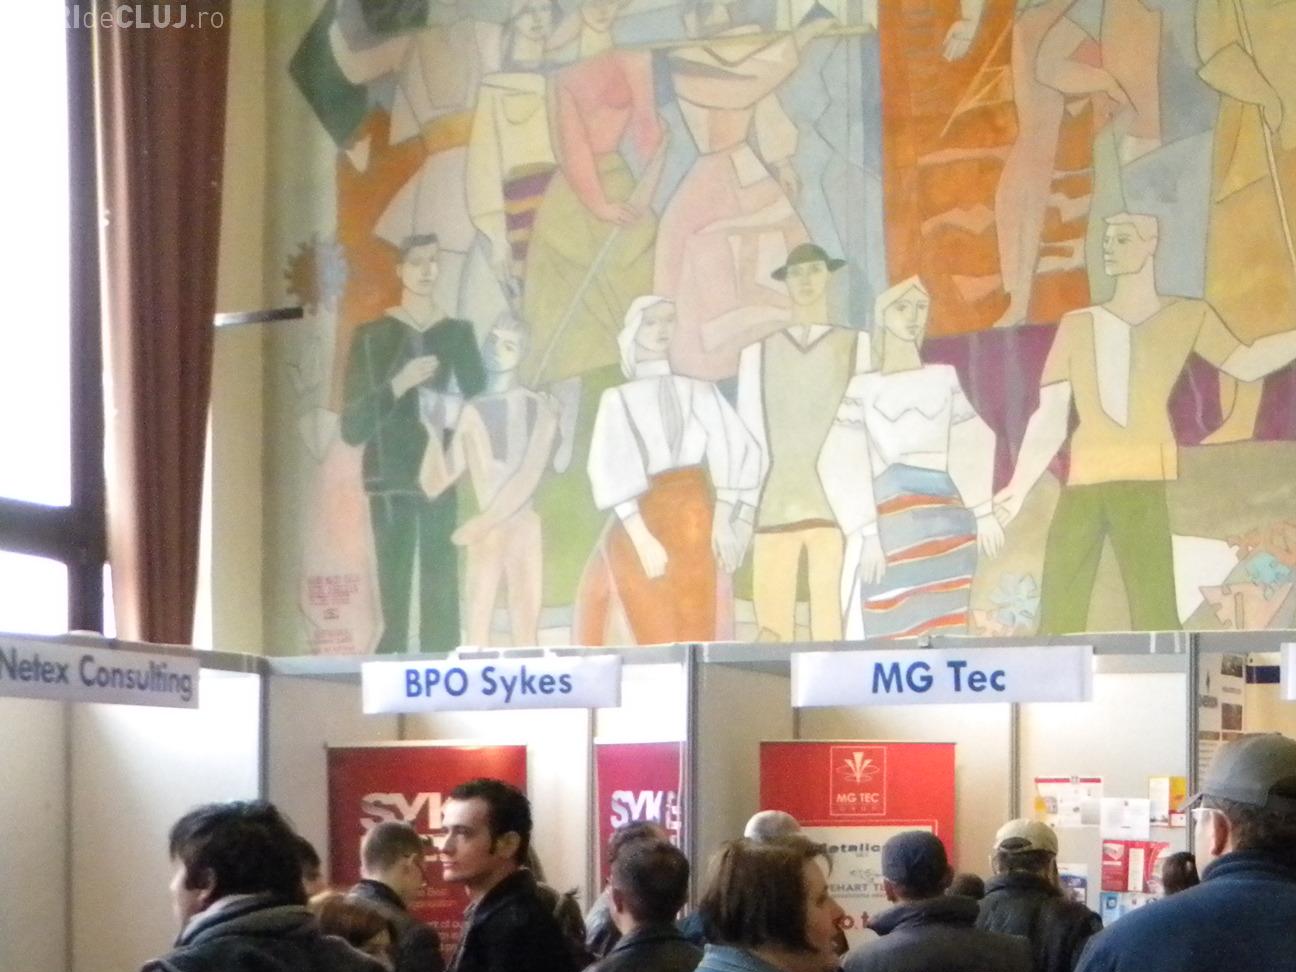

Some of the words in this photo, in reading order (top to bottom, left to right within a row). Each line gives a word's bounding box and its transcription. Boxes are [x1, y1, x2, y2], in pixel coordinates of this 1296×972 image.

[0, 647, 70, 684] Netex
[79, 654, 193, 702] Consulting
[405, 667, 469, 698] BPO
[481, 665, 573, 703] Sykes
[871, 661, 934, 694] MG
[946, 660, 1006, 692] Tec
[836, 793, 857, 803] MG
[860, 793, 880, 803] TEC
